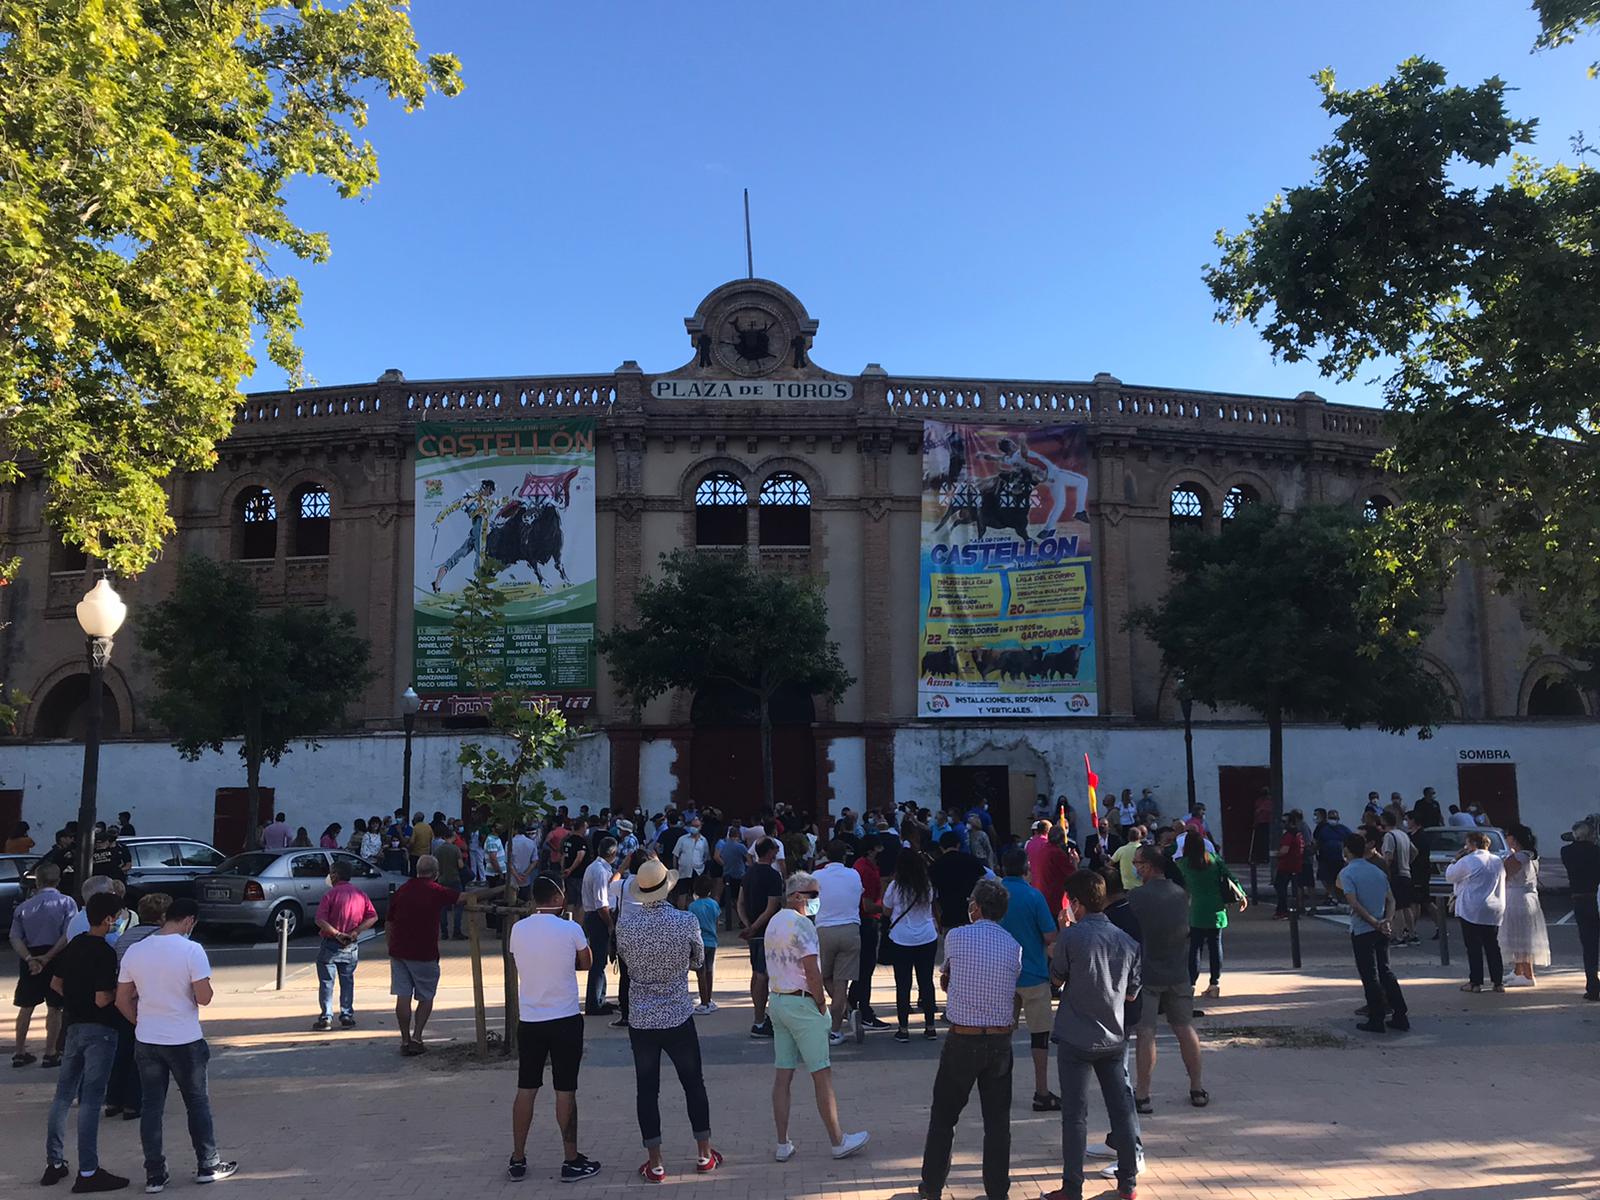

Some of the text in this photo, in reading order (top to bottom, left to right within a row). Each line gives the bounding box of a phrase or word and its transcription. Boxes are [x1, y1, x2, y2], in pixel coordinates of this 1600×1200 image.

[657, 382, 847, 398] PLAZA DE TOROS
[1009, 604, 1025, 615] 20
[927, 634, 942, 645] 22
[1459, 749, 1511, 760] SOMBRA
